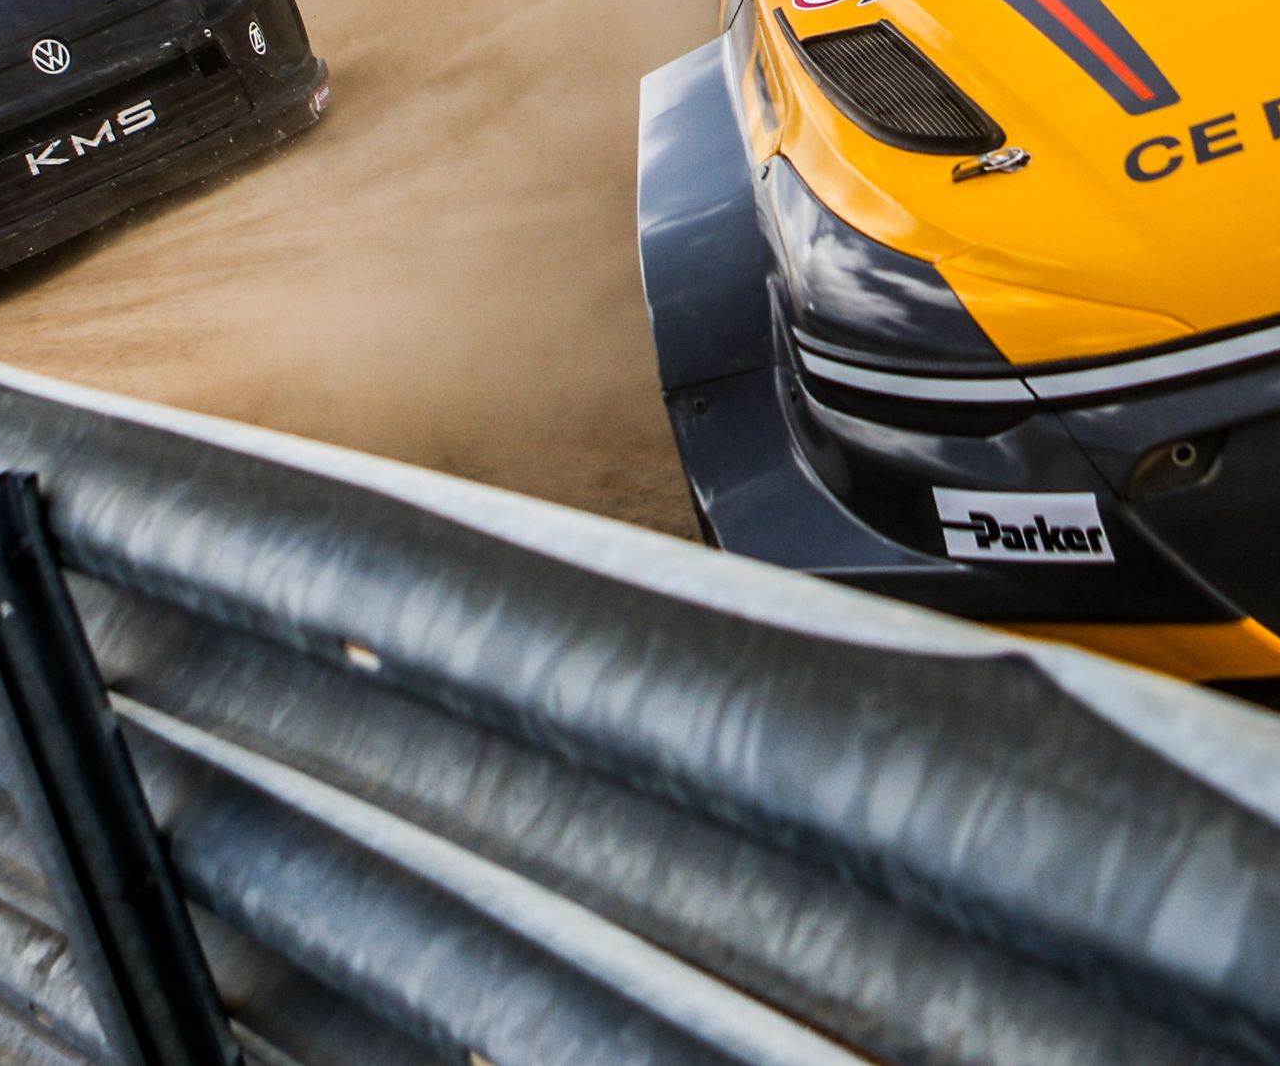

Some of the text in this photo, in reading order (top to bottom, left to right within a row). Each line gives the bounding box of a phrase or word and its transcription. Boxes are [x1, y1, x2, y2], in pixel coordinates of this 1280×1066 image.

[24, 99, 157, 177] KMS
[1123, 112, 1244, 184] CE
[968, 509, 1104, 555] Parker
